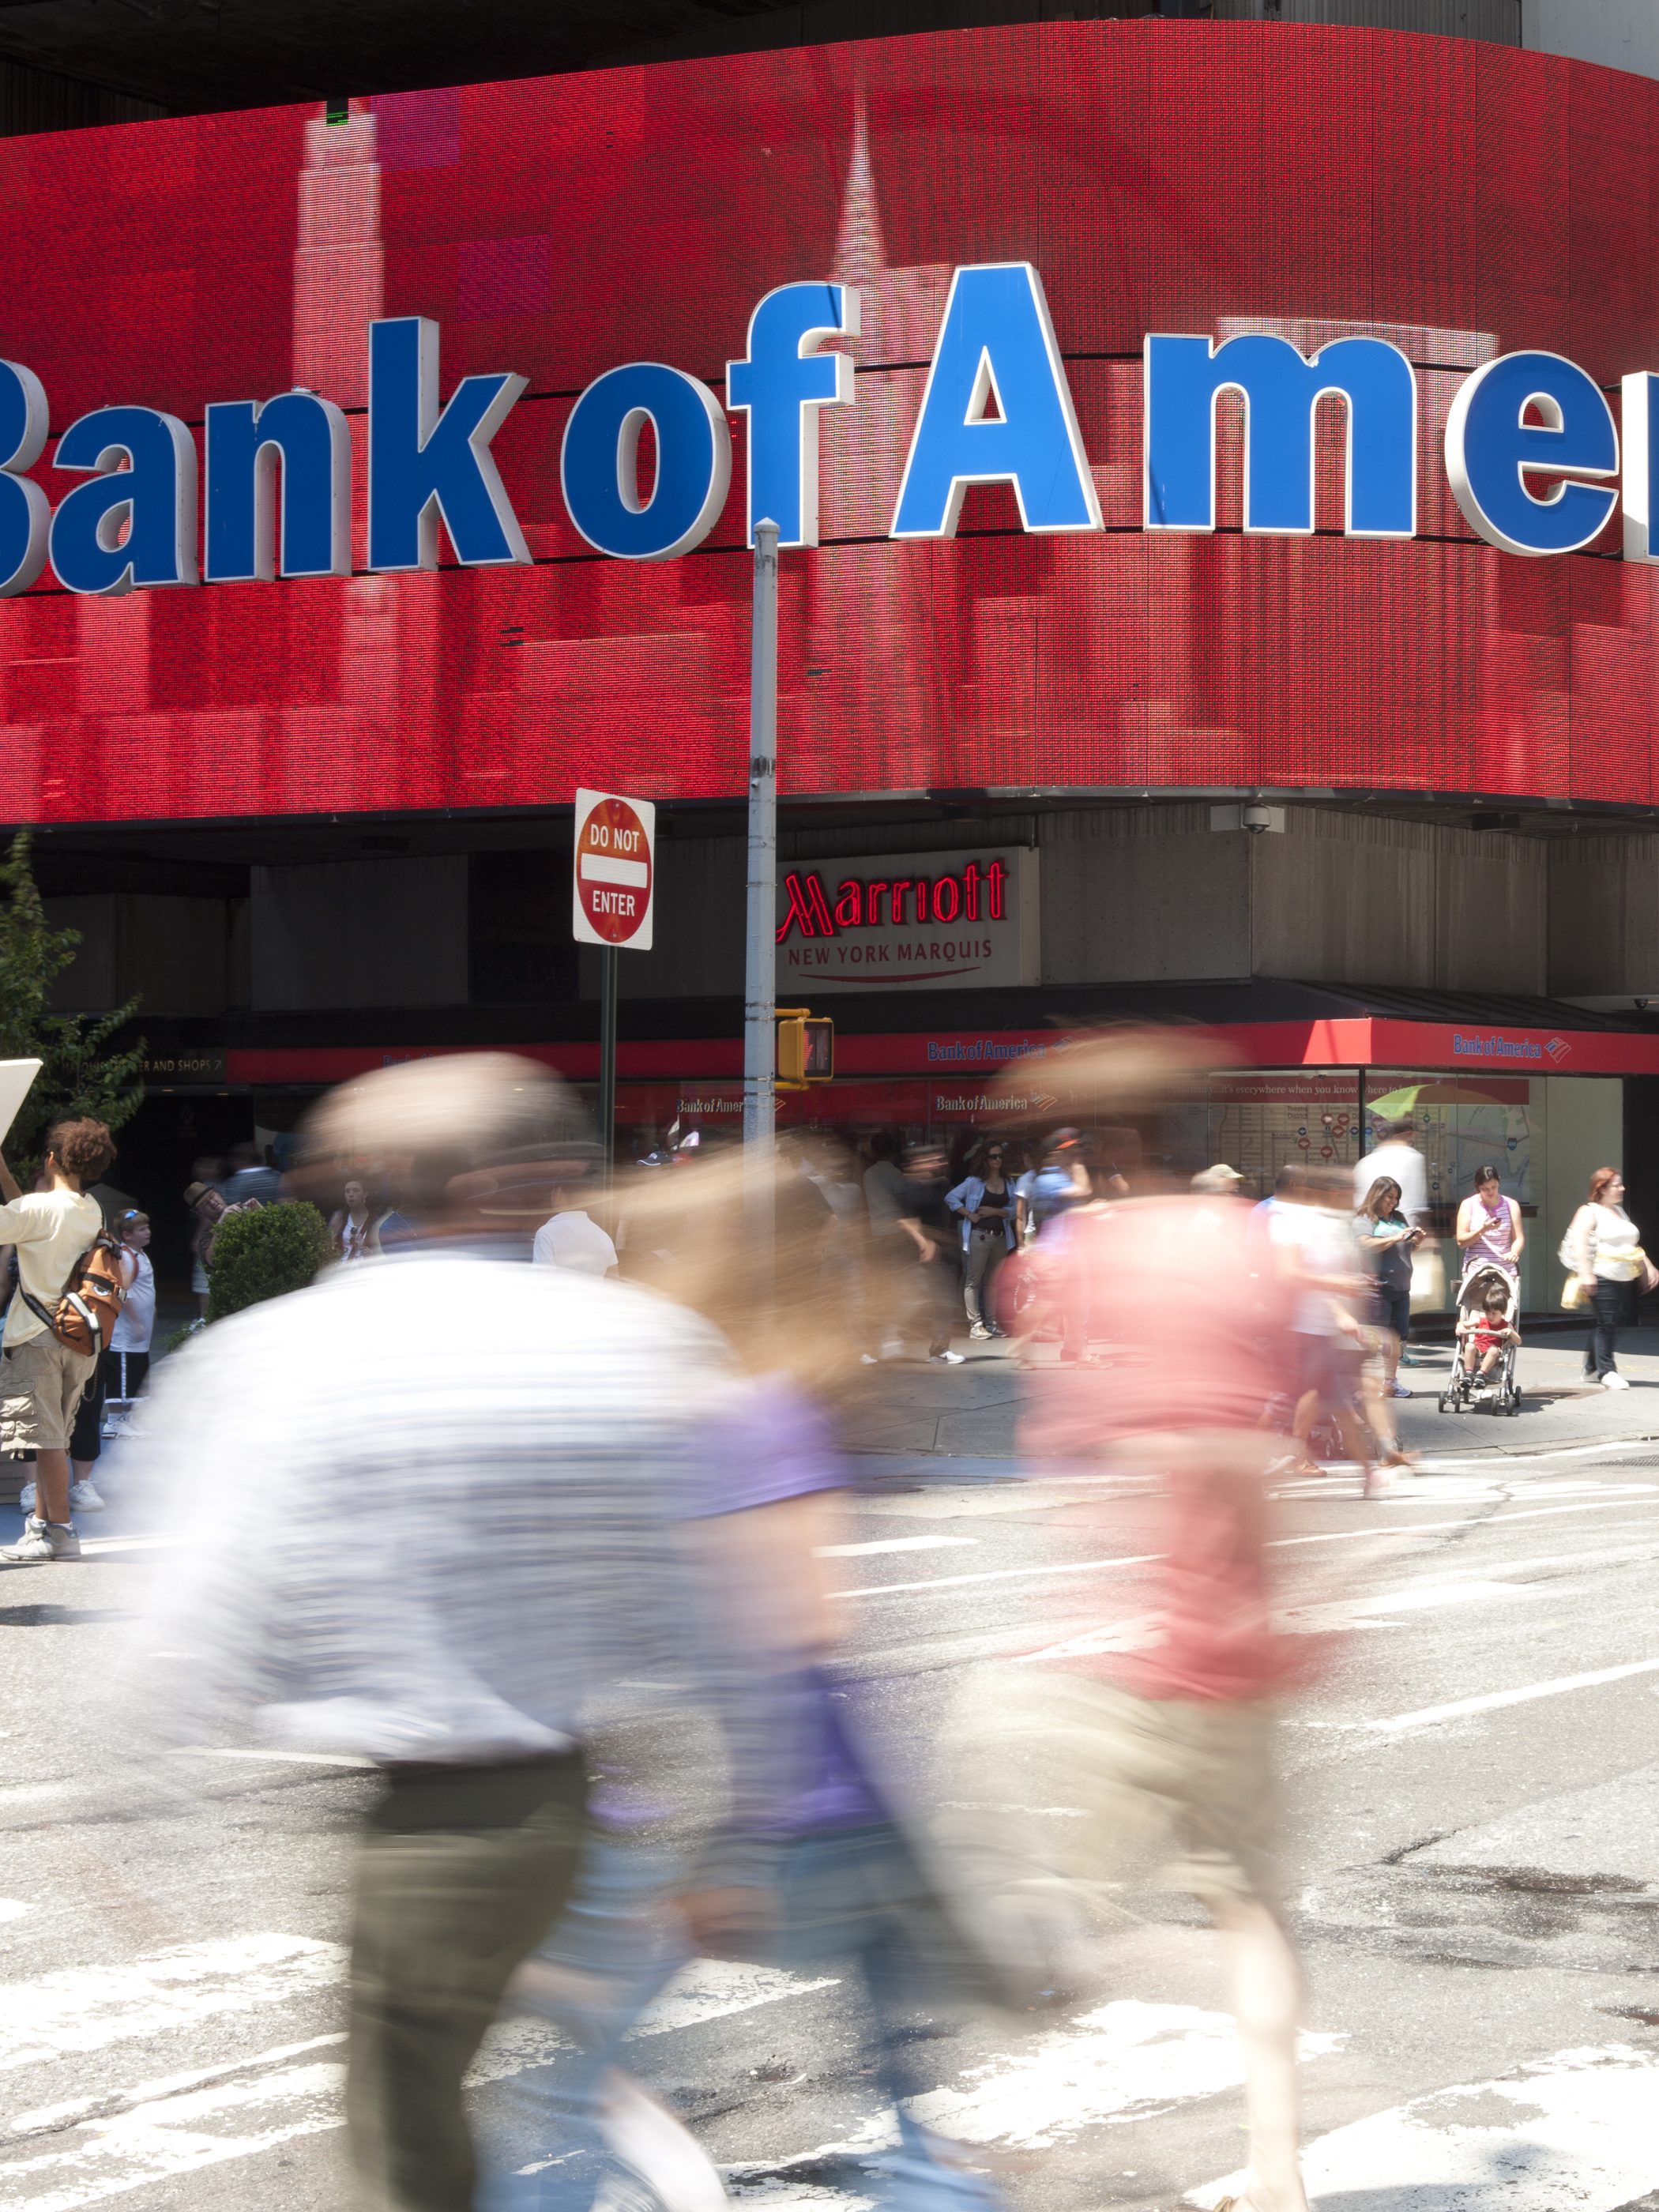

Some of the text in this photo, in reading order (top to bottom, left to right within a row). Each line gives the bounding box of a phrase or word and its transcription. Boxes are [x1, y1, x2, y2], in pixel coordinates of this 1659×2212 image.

[560, 281, 860, 562] of
[889, 261, 1659, 561] Ame
[590, 823, 640, 853] DO NOT
[592, 890, 635, 917] ENTER
[775, 857, 1010, 946] Marriott
[788, 939, 993, 966] NEW YORK MARQUIS
[927, 1039, 1046, 1061] Bank of America
[1454, 1033, 1542, 1059] Bank of America
[152, 1059, 175, 1072] AND
[178, 1059, 211, 1072] SHOPS
[935, 1094, 1027, 1111] Bank of America
[1236, 1084, 1286, 1096] everywhere
[1288, 1084, 1313, 1094] when
[1315, 1086, 1332, 1096] you
[1334, 1084, 1358, 1094] know
[1389, 1085, 1398, 1094] to
[676, 1097, 743, 1113] Bank of Amer
